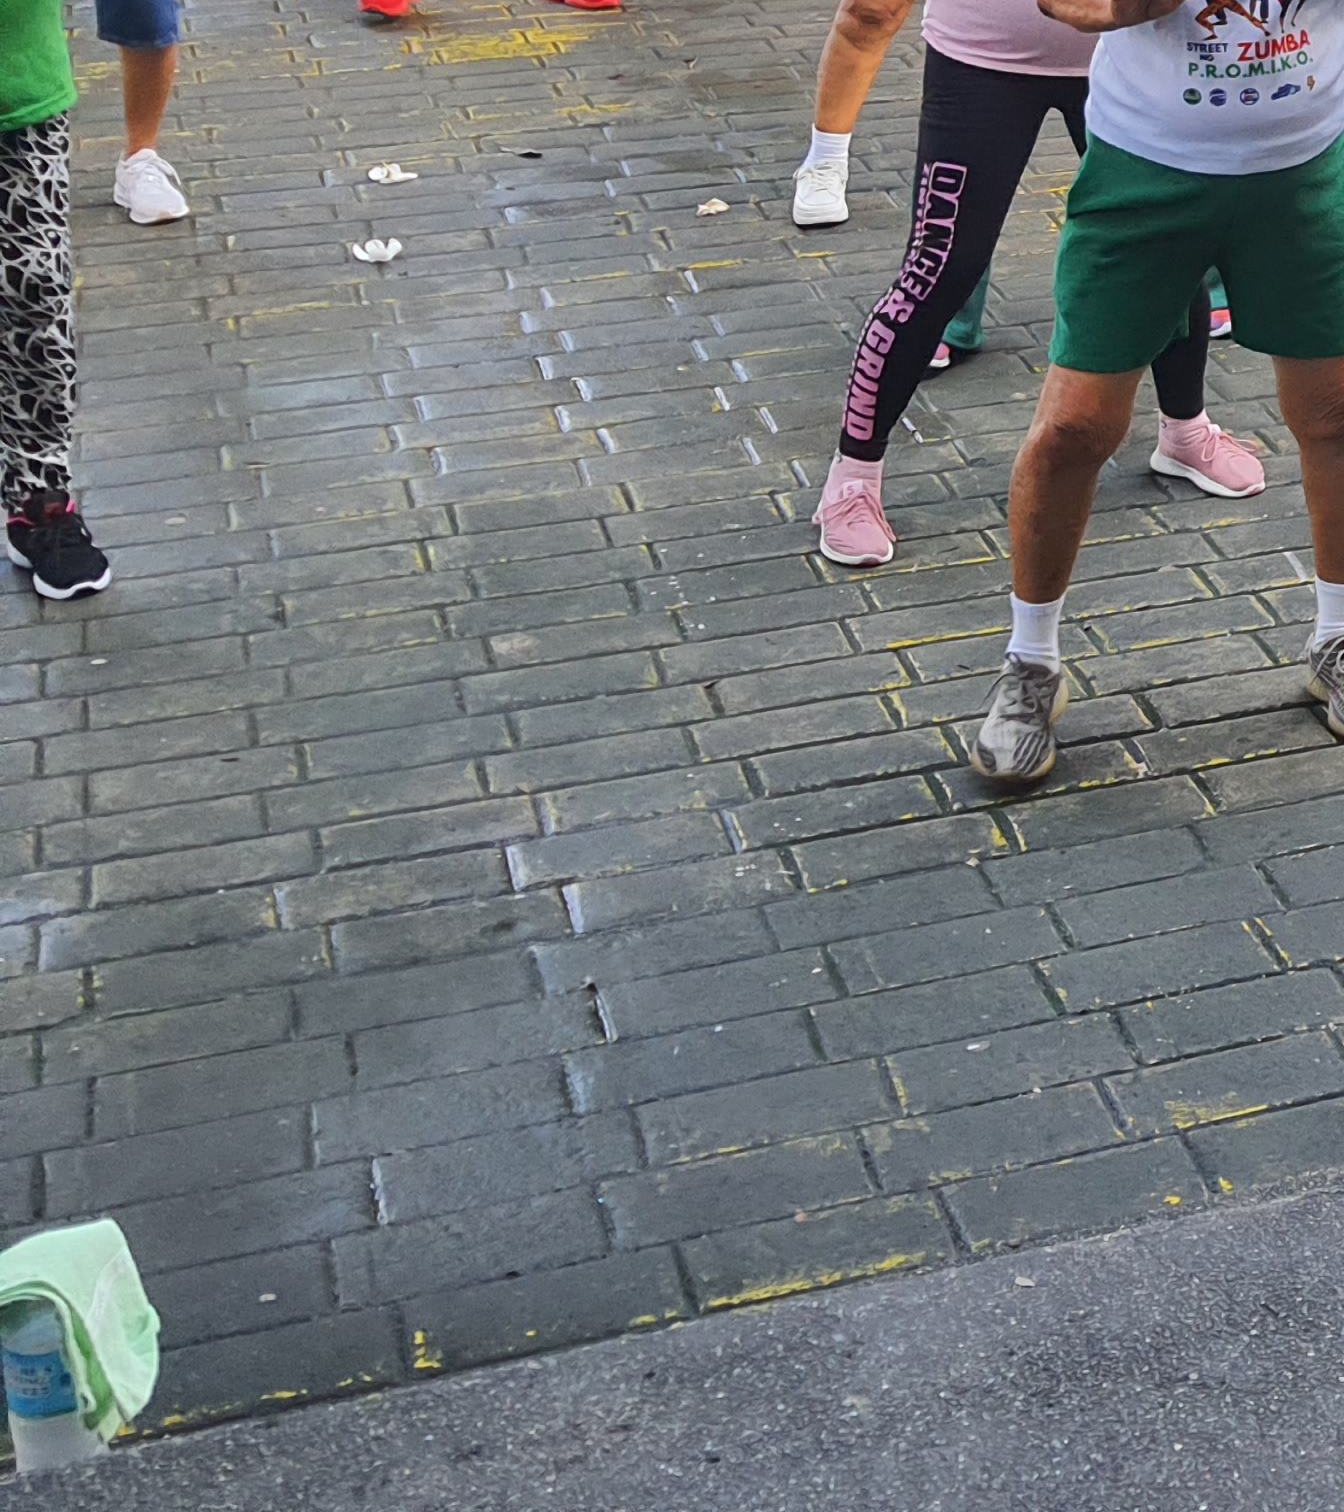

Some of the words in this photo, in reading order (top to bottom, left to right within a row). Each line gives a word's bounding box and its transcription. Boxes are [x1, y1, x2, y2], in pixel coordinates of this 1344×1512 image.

[1187, 42, 1229, 53] STREET
[1237, 29, 1311, 61] ZUMBA
[901, 161, 968, 301] DANCE
[846, 318, 896, 441] GRIND
